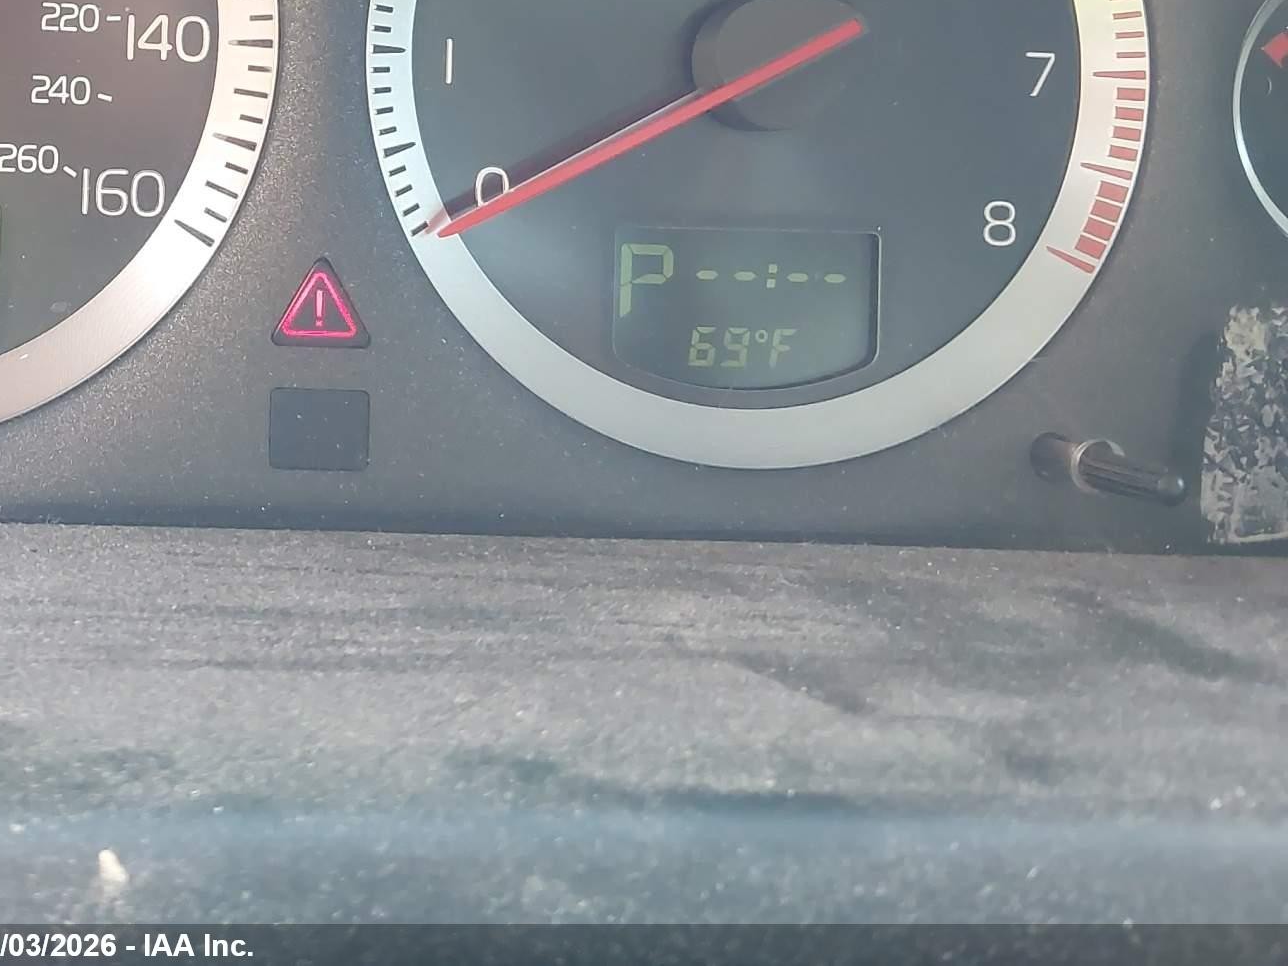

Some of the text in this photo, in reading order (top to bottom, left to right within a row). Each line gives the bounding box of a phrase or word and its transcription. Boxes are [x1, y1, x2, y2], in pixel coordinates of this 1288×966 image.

[41, 3, 100, 32] 220
[125, 13, 211, 63] 140
[445, 37, 452, 84] 1
[1025, 50, 1056, 97] 7
[31, 76, 91, 105] 240
[80, 168, 166, 218] 160
[983, 200, 1017, 246] 8
[620, 242, 674, 317] P
[688, 325, 797, 368] 69°F
